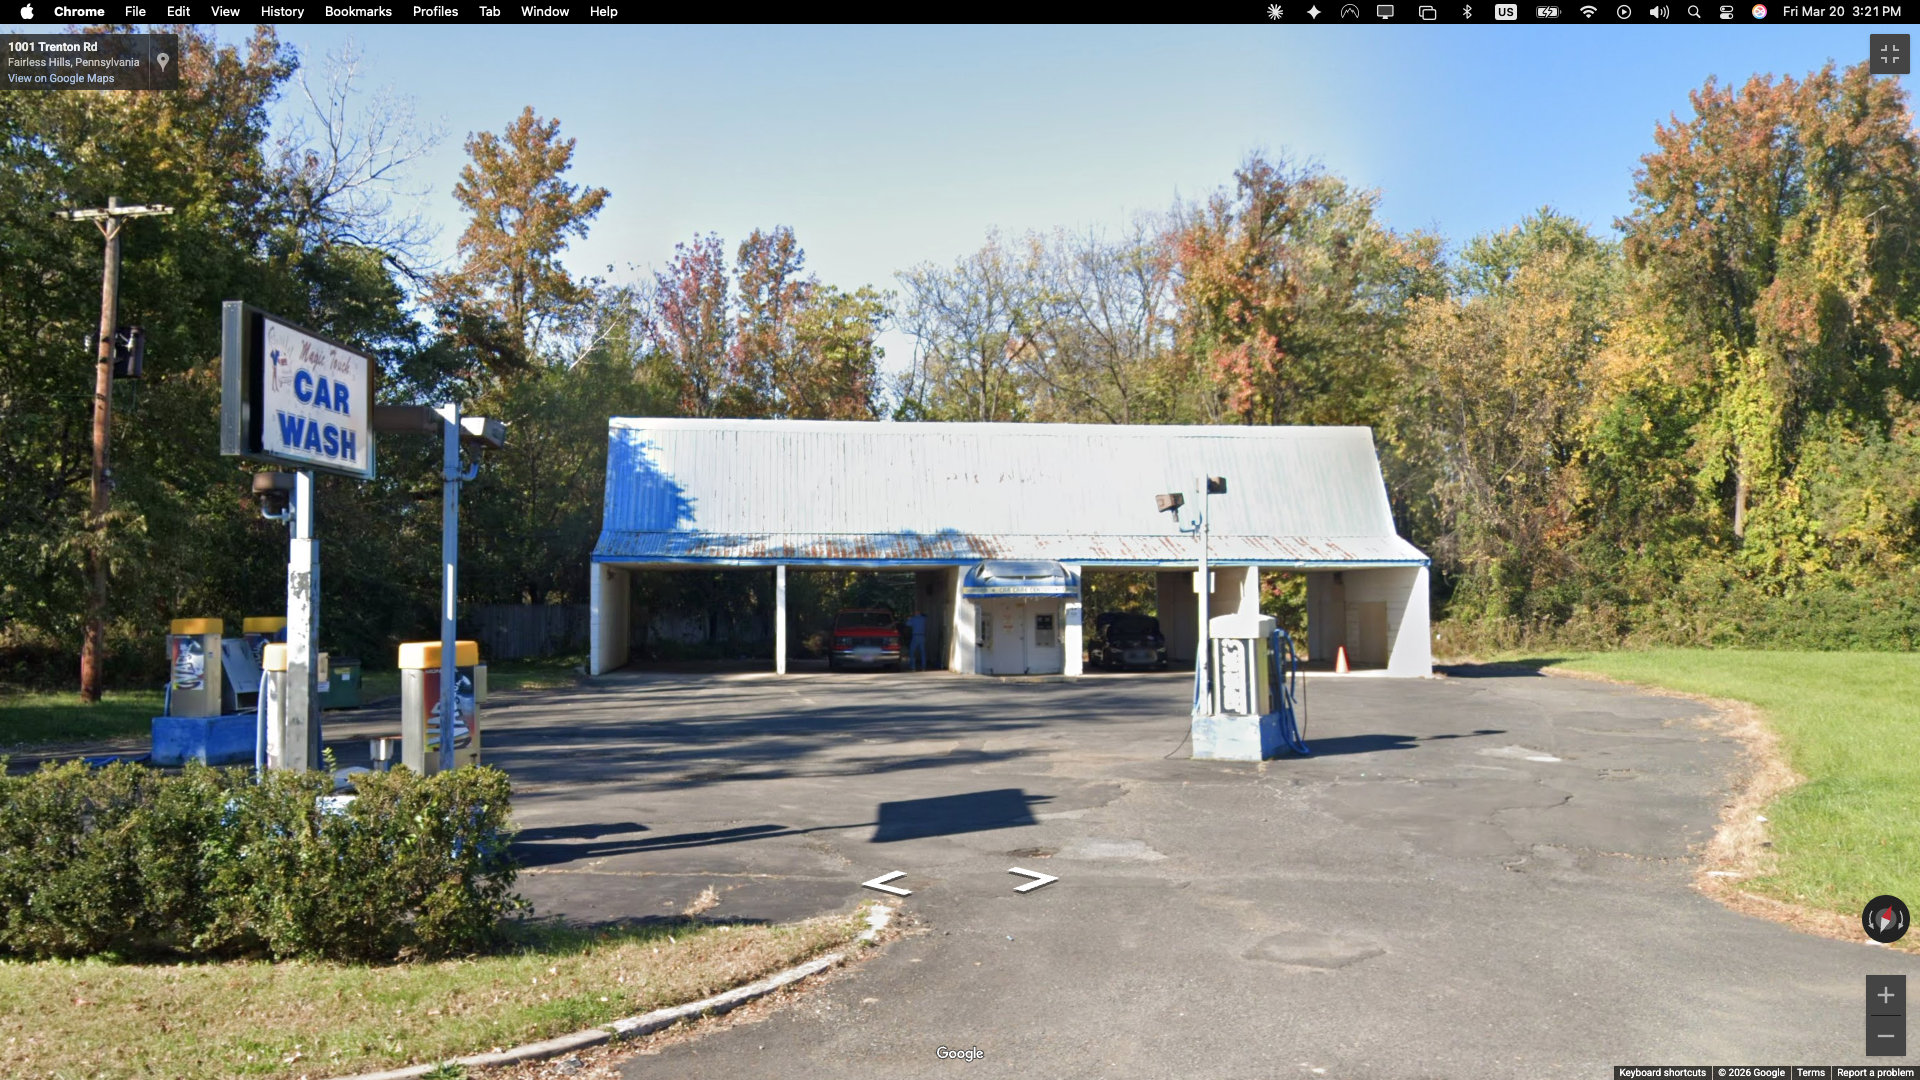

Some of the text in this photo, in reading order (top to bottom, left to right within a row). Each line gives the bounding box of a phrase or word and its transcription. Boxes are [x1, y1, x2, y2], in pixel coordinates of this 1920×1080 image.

[300, 340, 351, 374] Magic Touch
[293, 368, 350, 416] CAR
[277, 410, 357, 463] WASH
